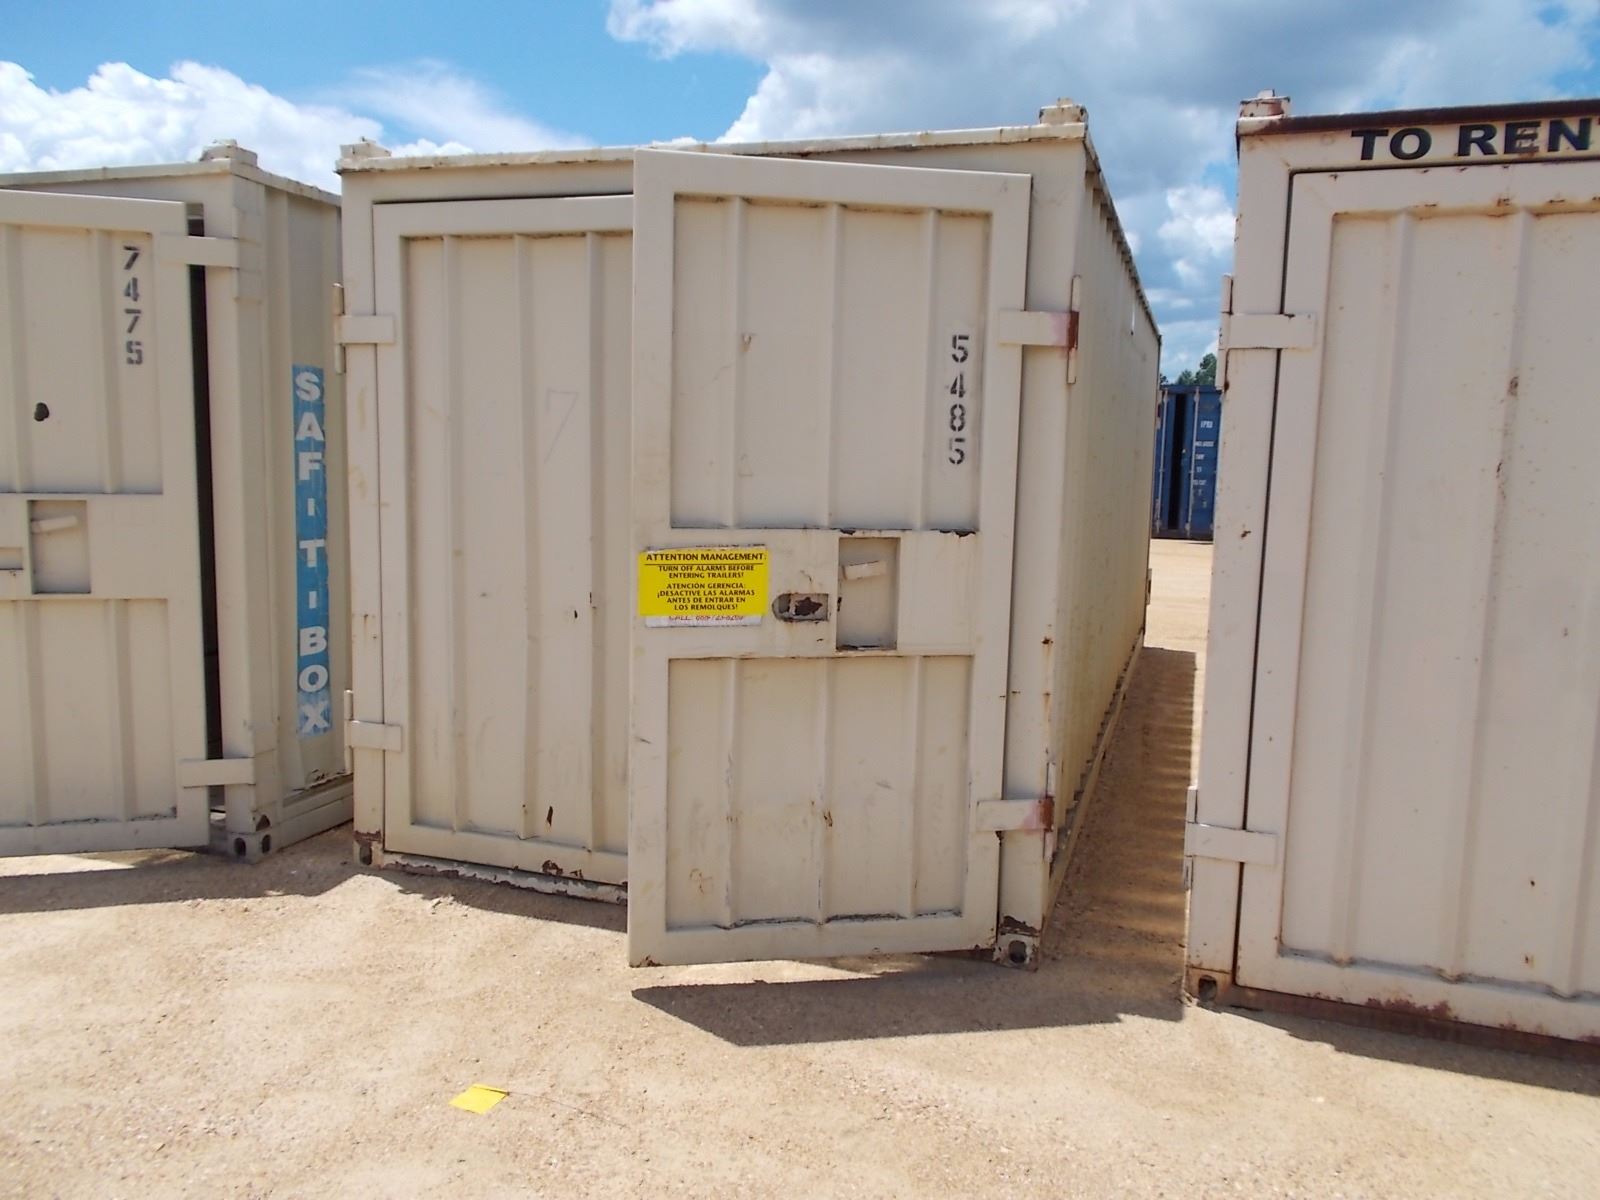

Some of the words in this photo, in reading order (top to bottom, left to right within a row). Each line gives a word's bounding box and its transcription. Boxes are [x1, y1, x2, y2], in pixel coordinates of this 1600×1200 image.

[1351, 127, 1432, 161] TO
[1457, 117, 1600, 157] REN
[123, 245, 143, 365] 7475
[949, 335, 969, 464] 5485
[295, 371, 330, 731] SAFITIBOX
[646, 553, 699, 561] ATTENTION
[690, 603, 738, 611] REMOLQUES!
